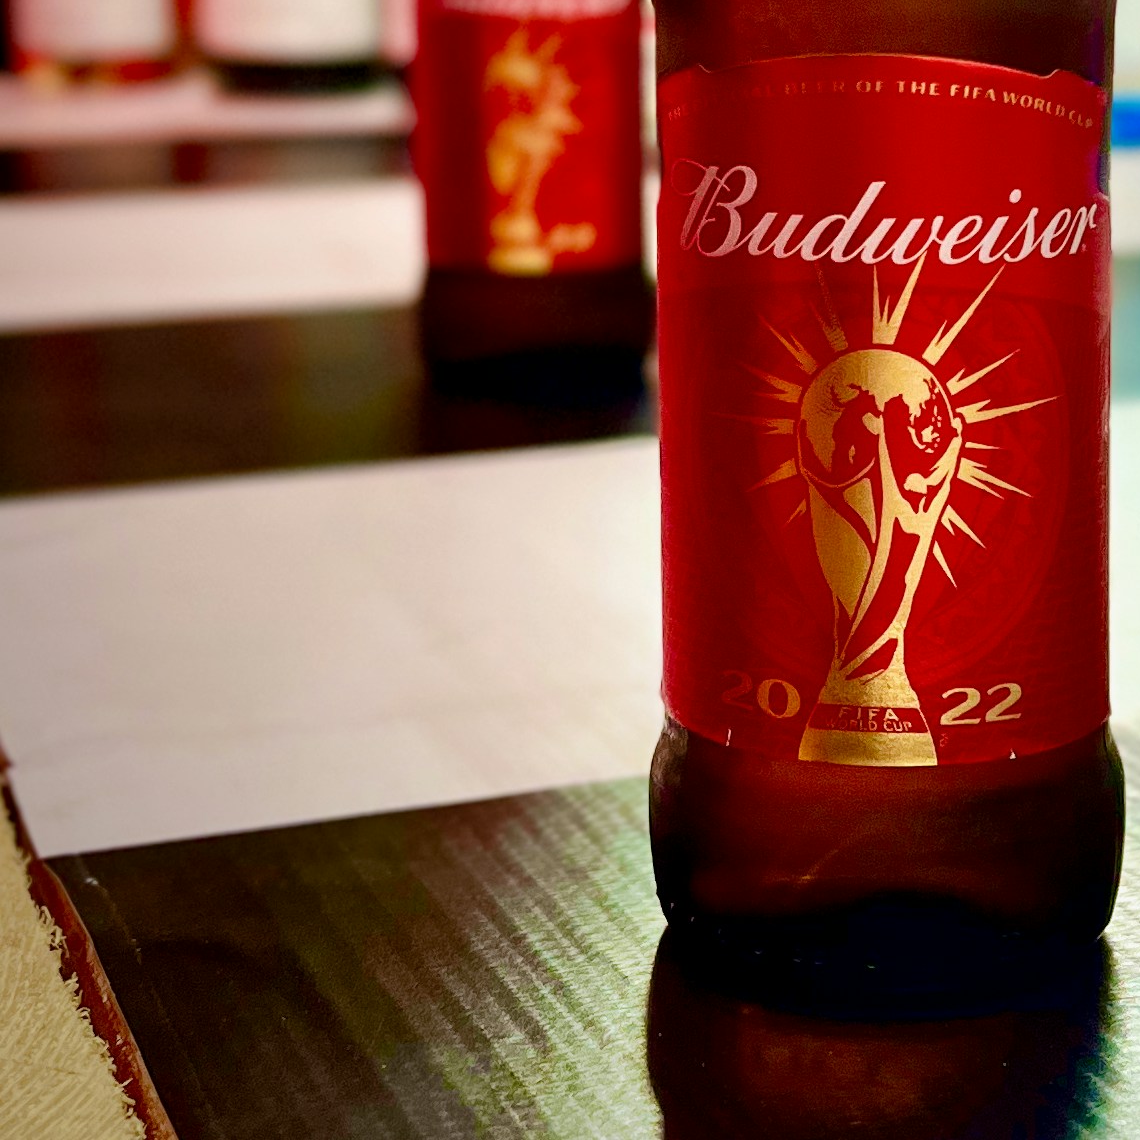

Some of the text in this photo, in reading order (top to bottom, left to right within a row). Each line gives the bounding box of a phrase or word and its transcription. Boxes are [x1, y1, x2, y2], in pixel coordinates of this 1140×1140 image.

[856, 79, 883, 94] OF
[897, 80, 940, 96] THE
[950, 84, 997, 102] FIFA
[1002, 91, 1066, 117] WORLD
[671, 159, 1097, 265] Budweiser
[721, 669, 1022, 725] 20 22
[839, 707, 900, 721] FIFA
[883, 720, 912, 732] CUP
